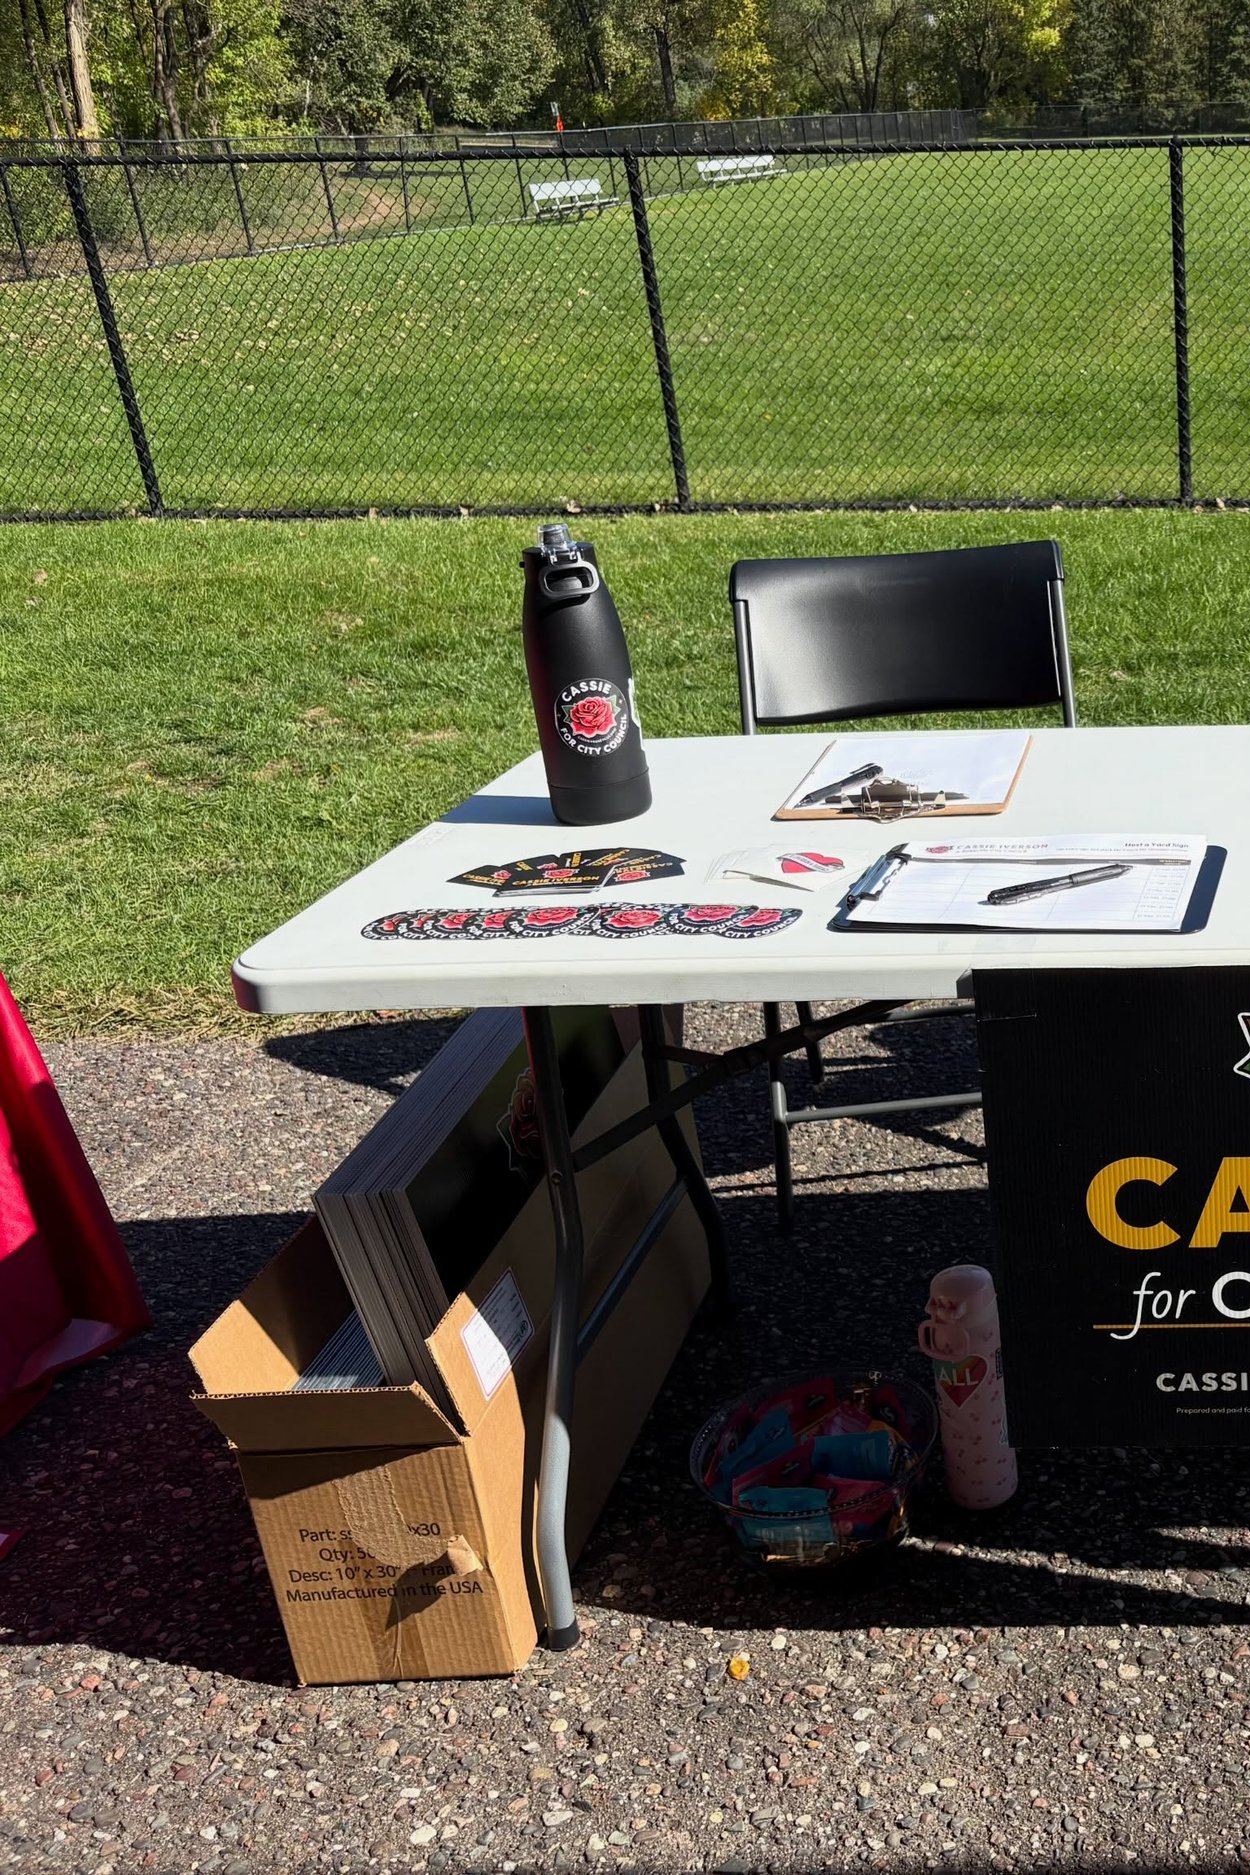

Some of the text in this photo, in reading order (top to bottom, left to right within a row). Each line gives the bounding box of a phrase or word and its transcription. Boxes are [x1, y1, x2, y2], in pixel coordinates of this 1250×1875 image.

[562, 681, 612, 702] CASSIE
[560, 727, 577, 748] FOR
[577, 744, 602, 755] CITY
[604, 714, 626, 753] COUNCIL
[522, 929, 550, 937] CITY
[597, 929, 620, 938] CITY
[675, 923, 698, 932] CITY
[724, 930, 752, 938] CITY
[1109, 1271, 1196, 1340] for
[939, 1367, 979, 1387] ALL
[1176, 1407, 1211, 1415] Prepared
[1226, 1407, 1243, 1415] paid
[299, 1528, 336, 1543] Part:
[319, 1548, 355, 1563] Qty:
[288, 1569, 333, 1583] Desc:
[364, 1569, 375, 1579] x
[286, 1581, 484, 1604] Manufactured in the USA
